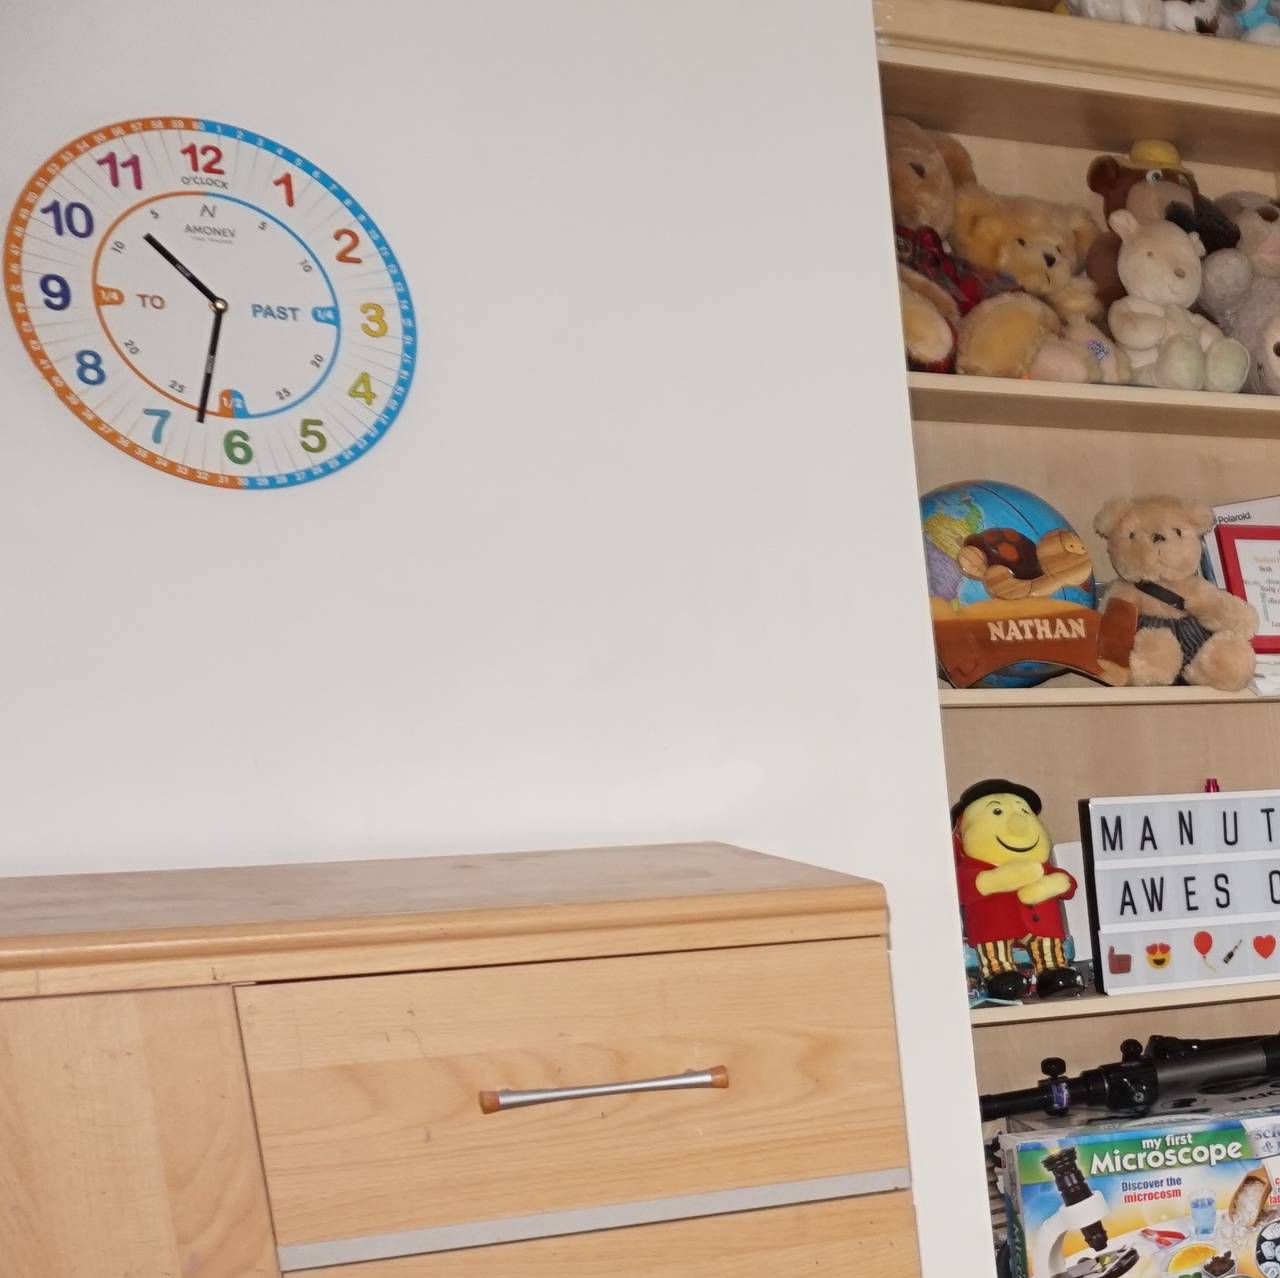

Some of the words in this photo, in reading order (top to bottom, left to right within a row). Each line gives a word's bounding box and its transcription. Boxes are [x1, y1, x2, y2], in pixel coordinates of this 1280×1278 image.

[97, 152, 143, 190] 11
[181, 143, 225, 175] 12
[180, 176, 229, 189] O'CLOCK
[273, 172, 294, 208] 1
[40, 200, 95, 239] 10
[333, 228, 363, 264] 2
[39, 273, 71, 311] 9
[136, 293, 165, 309] TO
[251, 303, 300, 321] PAST
[360, 302, 388, 337] 3
[76, 350, 106, 385] 8
[348, 372, 377, 406] 4
[143, 408, 172, 444] 7
[299, 418, 327, 453] 5
[223, 430, 253, 465] 6
[1218, 512, 1251, 524] Polaroid
[988, 618, 1086, 642] NATHAN
[1090, 1141, 1243, 1175] Microscope
[1142, 1138, 1162, 1151] my
[1165, 1133, 1192, 1147] first
[1262, 1141, 1274, 1153] &
[1121, 1178, 1163, 1192] Discover
[1166, 1176, 1182, 1187] the
[1123, 1189, 1182, 1204] microcosm
